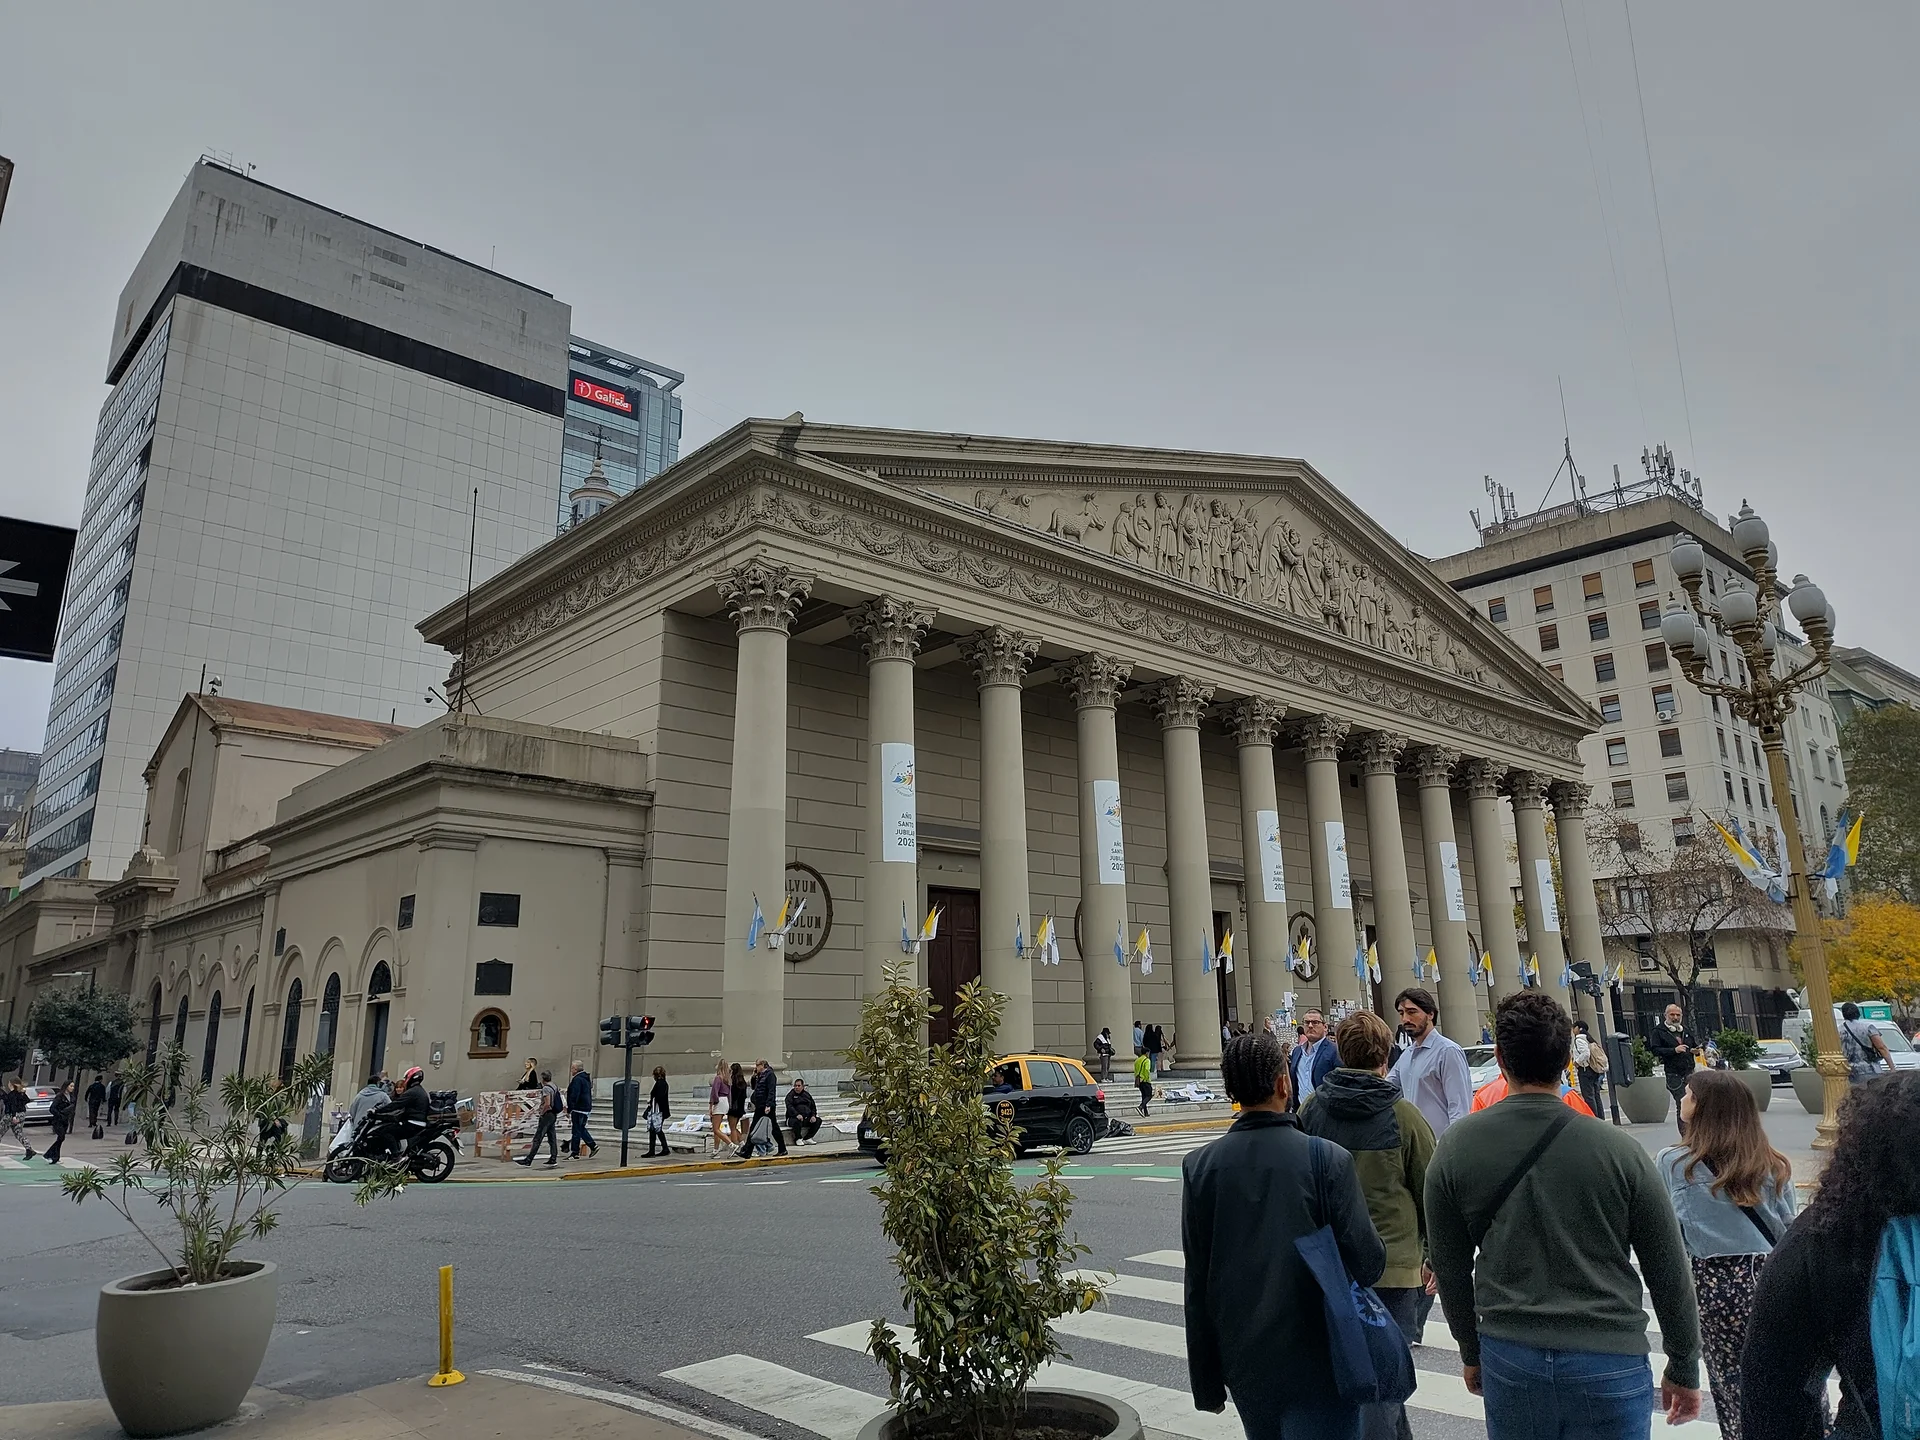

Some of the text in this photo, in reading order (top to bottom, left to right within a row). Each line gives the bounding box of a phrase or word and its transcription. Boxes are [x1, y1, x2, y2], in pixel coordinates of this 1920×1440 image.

[594, 389, 629, 408] Galicia
[901, 811, 912, 819] AÑO
[897, 837, 914, 847] 2025
[788, 932, 813, 946] UUM
